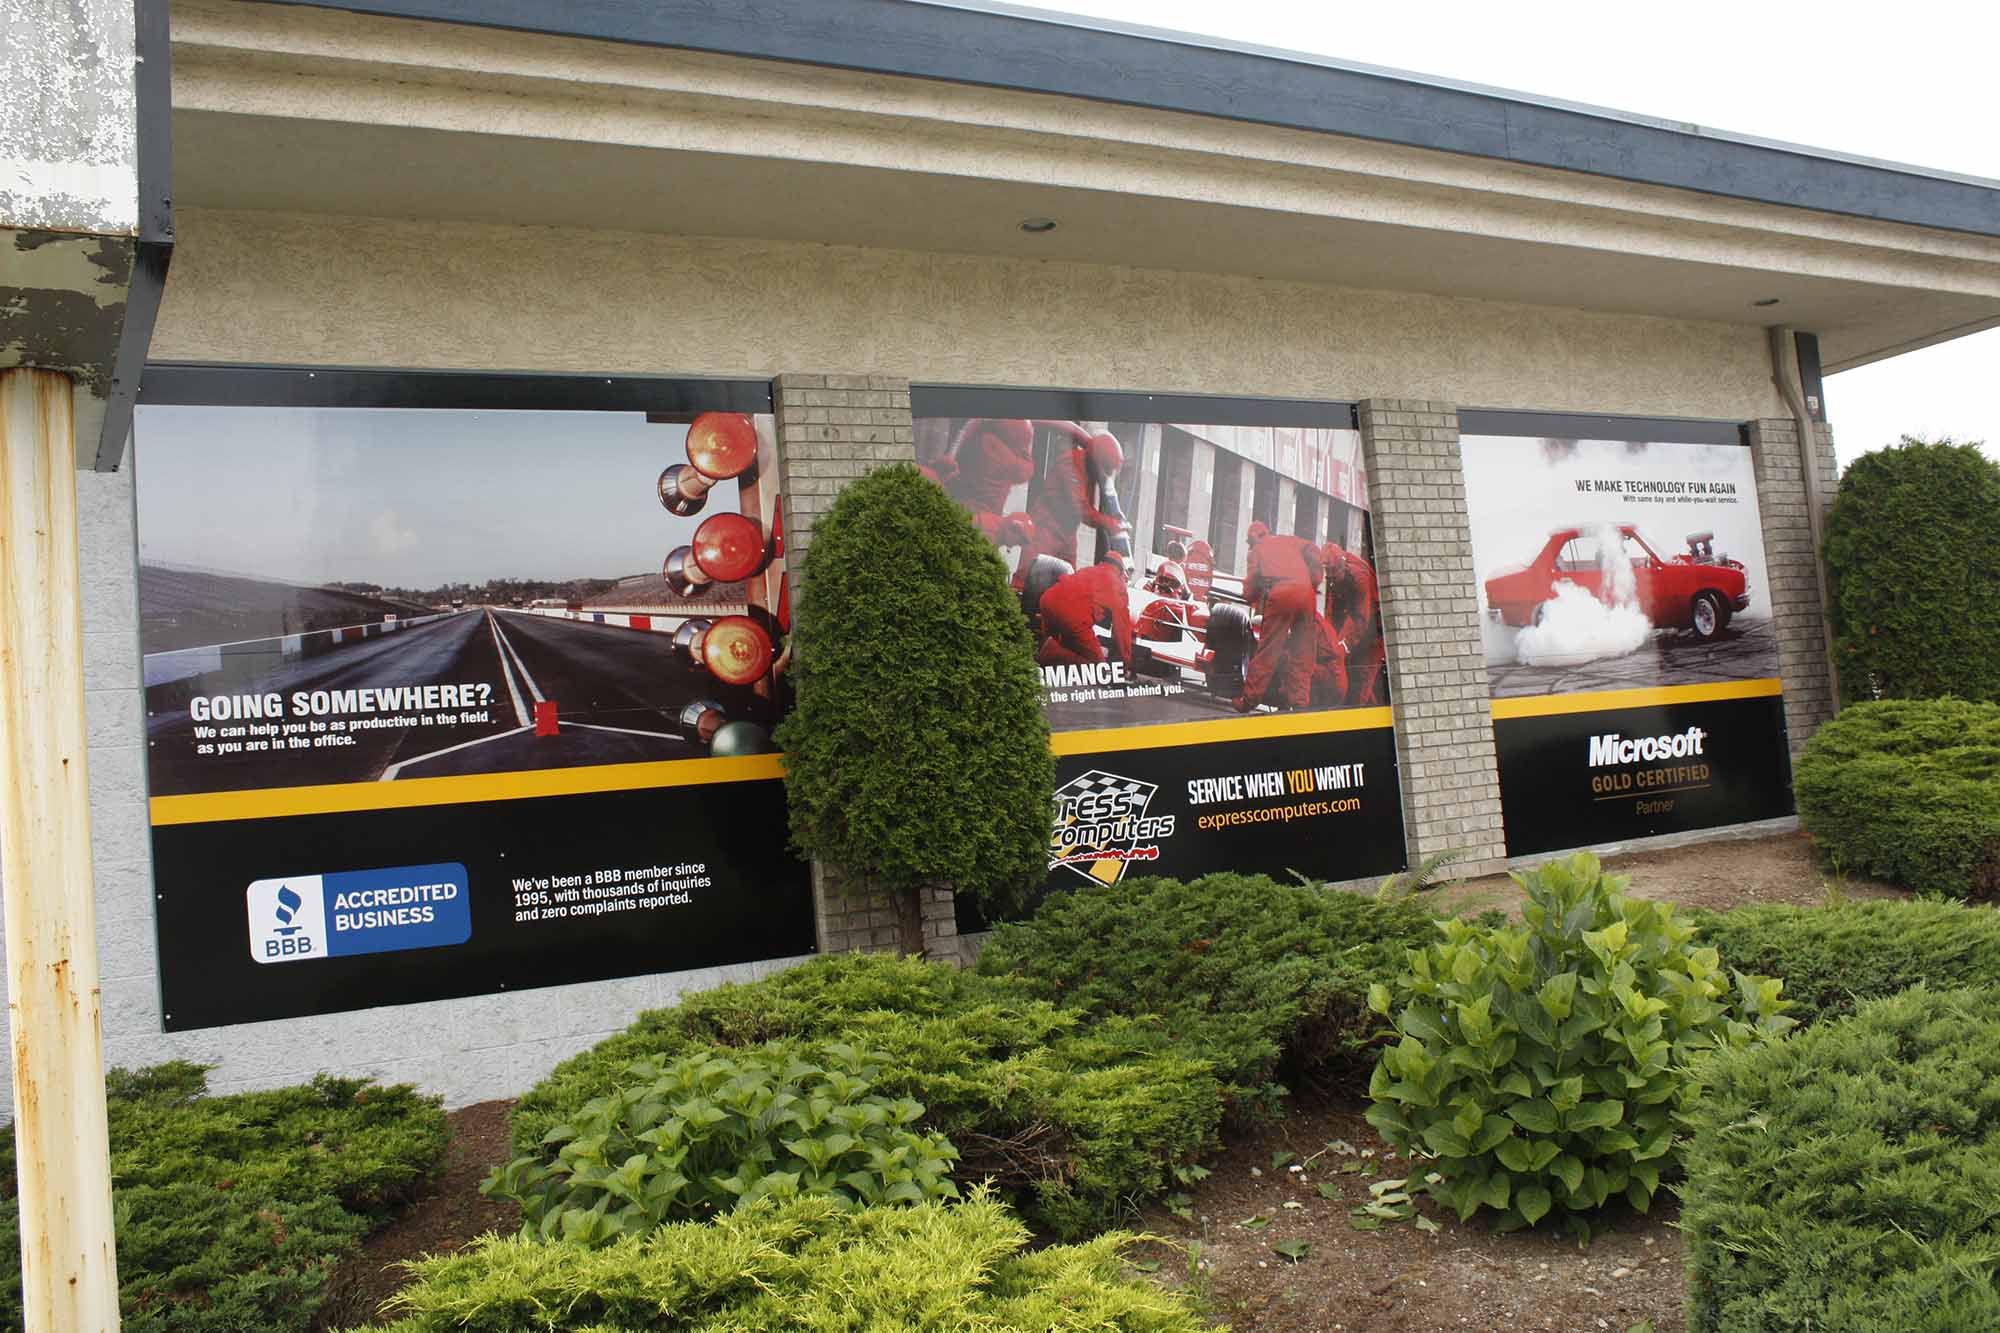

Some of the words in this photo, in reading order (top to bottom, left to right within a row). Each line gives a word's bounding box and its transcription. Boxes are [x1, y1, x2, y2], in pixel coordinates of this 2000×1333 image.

[1575, 480, 1592, 492] WE
[1594, 480, 1623, 492] MAKE
[1624, 480, 1686, 494] TECHNOLOGY
[1688, 482, 1707, 494] FUN
[1709, 482, 1736, 494] AGAIN
[190, 693, 283, 721] GOING
[292, 683, 491, 716] SOMEWHERE?
[1050, 691, 1068, 703] the
[1070, 689, 1096, 703] right
[1098, 688, 1125, 700] team
[1127, 683, 1162, 697] behind
[1163, 684, 1185, 697] you.
[194, 726, 216, 739] We
[220, 726, 246, 737] can
[249, 723, 279, 736] help
[283, 723, 306, 736] you
[310, 720, 327, 732] be
[330, 721, 346, 731] as
[349, 715, 417, 732] productive
[421, 714, 433, 725] in
[436, 713, 457, 725] the
[460, 711, 489, 723] field
[197, 744, 214, 754] as
[217, 742, 242, 755] you
[246, 741, 269, 751] are
[272, 738, 285, 749] in
[288, 737, 311, 748] the
[314, 734, 357, 747] office.
[1589, 726, 1704, 767] Microsoft
[1187, 775, 1244, 805] SERVICE
[1244, 771, 1285, 798] WHEN
[1286, 768, 1315, 794] YOU
[1314, 764, 1351, 791] WANT
[1352, 763, 1365, 787] IT
[1592, 773, 1632, 793] GOLD
[1636, 764, 1710, 787] CERTIFIED
[1198, 797, 1361, 831] expresscomputers.com
[1636, 799, 1675, 815] Partner
[512, 877, 549, 892] We've
[552, 874, 582, 888] been
[585, 875, 593, 885] a
[595, 869, 622, 884] BBB
[624, 865, 673, 880] member
[674, 862, 705, 875] since
[334, 883, 457, 910] ACCREDITED
[514, 891, 552, 907] 1995,
[554, 887, 580, 903] with
[582, 881, 645, 899] thousands
[647, 879, 659, 893] of
[661, 876, 711, 893] inquiries
[335, 907, 435, 931] BUSINESS
[515, 907, 539, 922] and
[541, 906, 567, 919] zero
[570, 897, 637, 916] complaints
[639, 892, 692, 910] reported.
[265, 936, 312, 957] BBB
